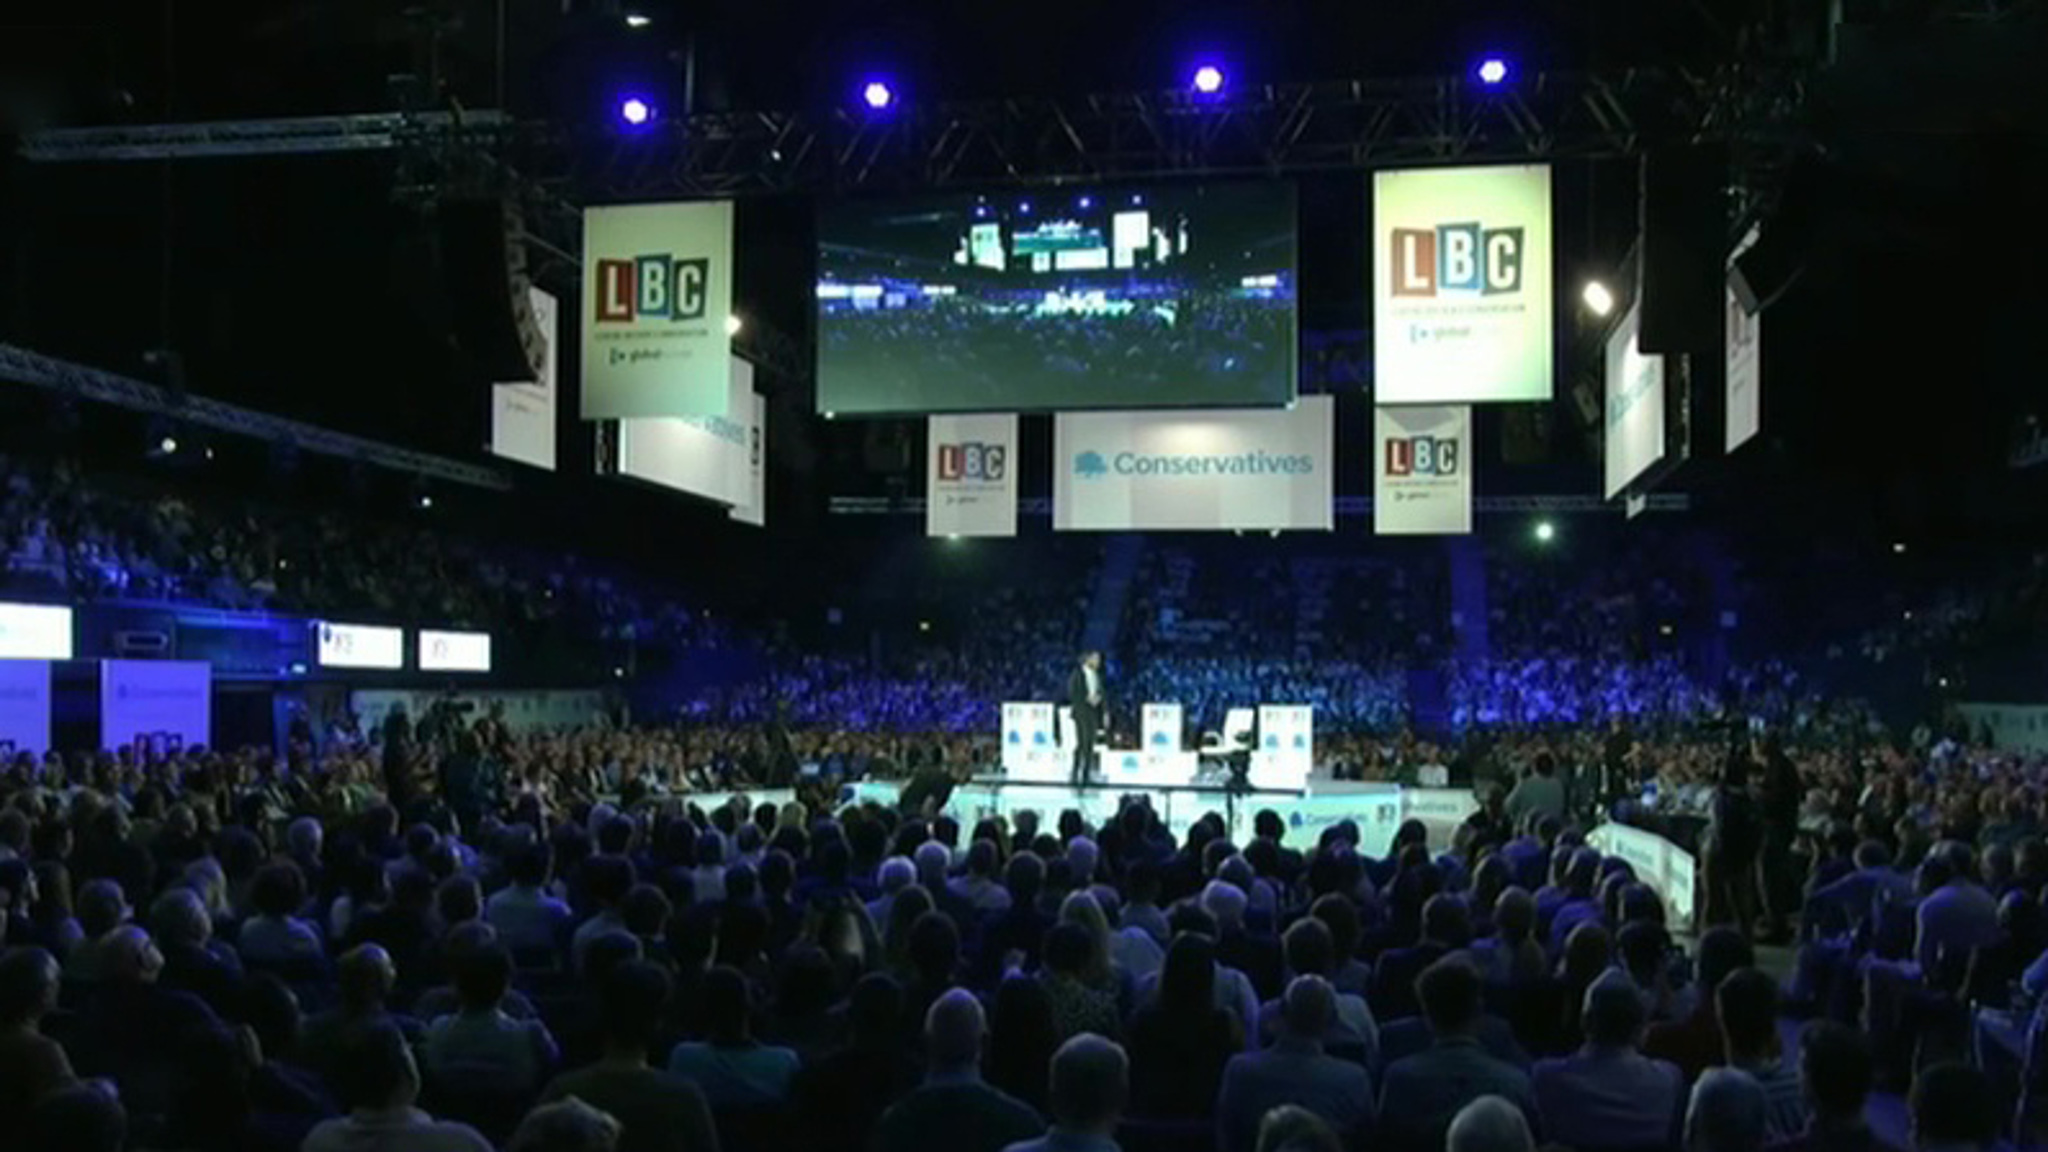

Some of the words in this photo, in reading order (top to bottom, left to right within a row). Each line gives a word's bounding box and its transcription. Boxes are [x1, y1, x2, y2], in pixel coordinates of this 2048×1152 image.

[1400, 227, 1519, 293] LBC
[601, 257, 705, 317] LBC
[941, 443, 1003, 479] LBC
[1114, 450, 1313, 475] Conservatives
[1390, 438, 1456, 474] LBC
